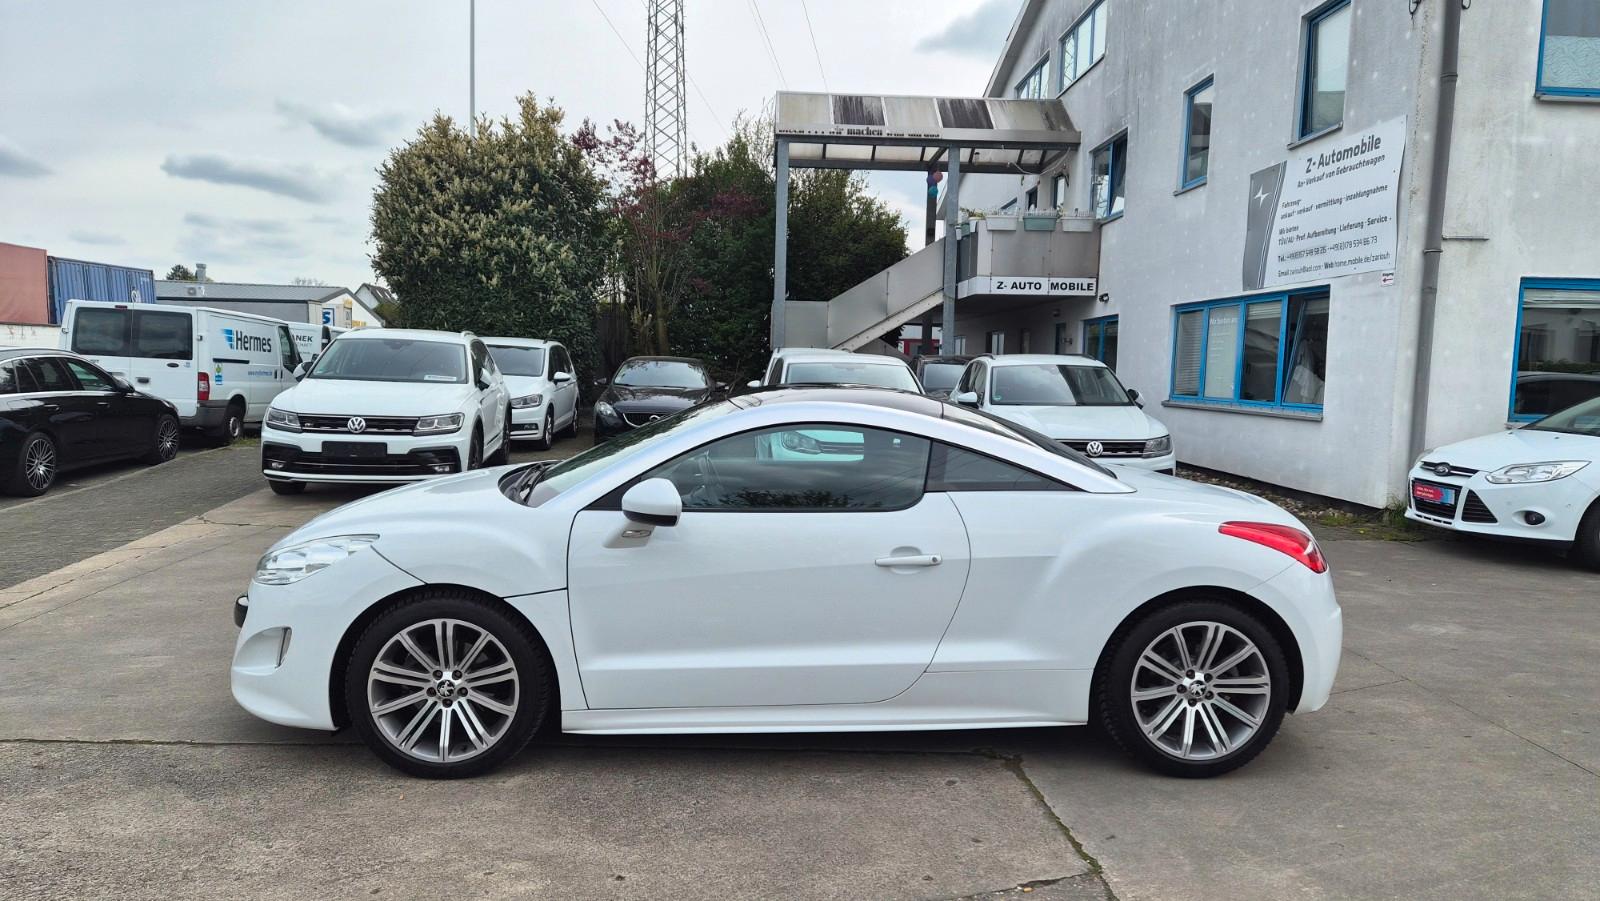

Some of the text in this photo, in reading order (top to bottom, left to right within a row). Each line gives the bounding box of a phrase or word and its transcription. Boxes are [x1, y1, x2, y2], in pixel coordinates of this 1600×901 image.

[1325, 170, 1335, 179] von
[1336, 154, 1385, 176] Gebrauchtwagen
[1339, 220, 1364, 232] Lieferung
[1367, 215, 1388, 226] Service
[1011, 281, 1042, 290] AUTO
[1051, 282, 1094, 291] MOBILE
[235, 329, 272, 353] Hermes
